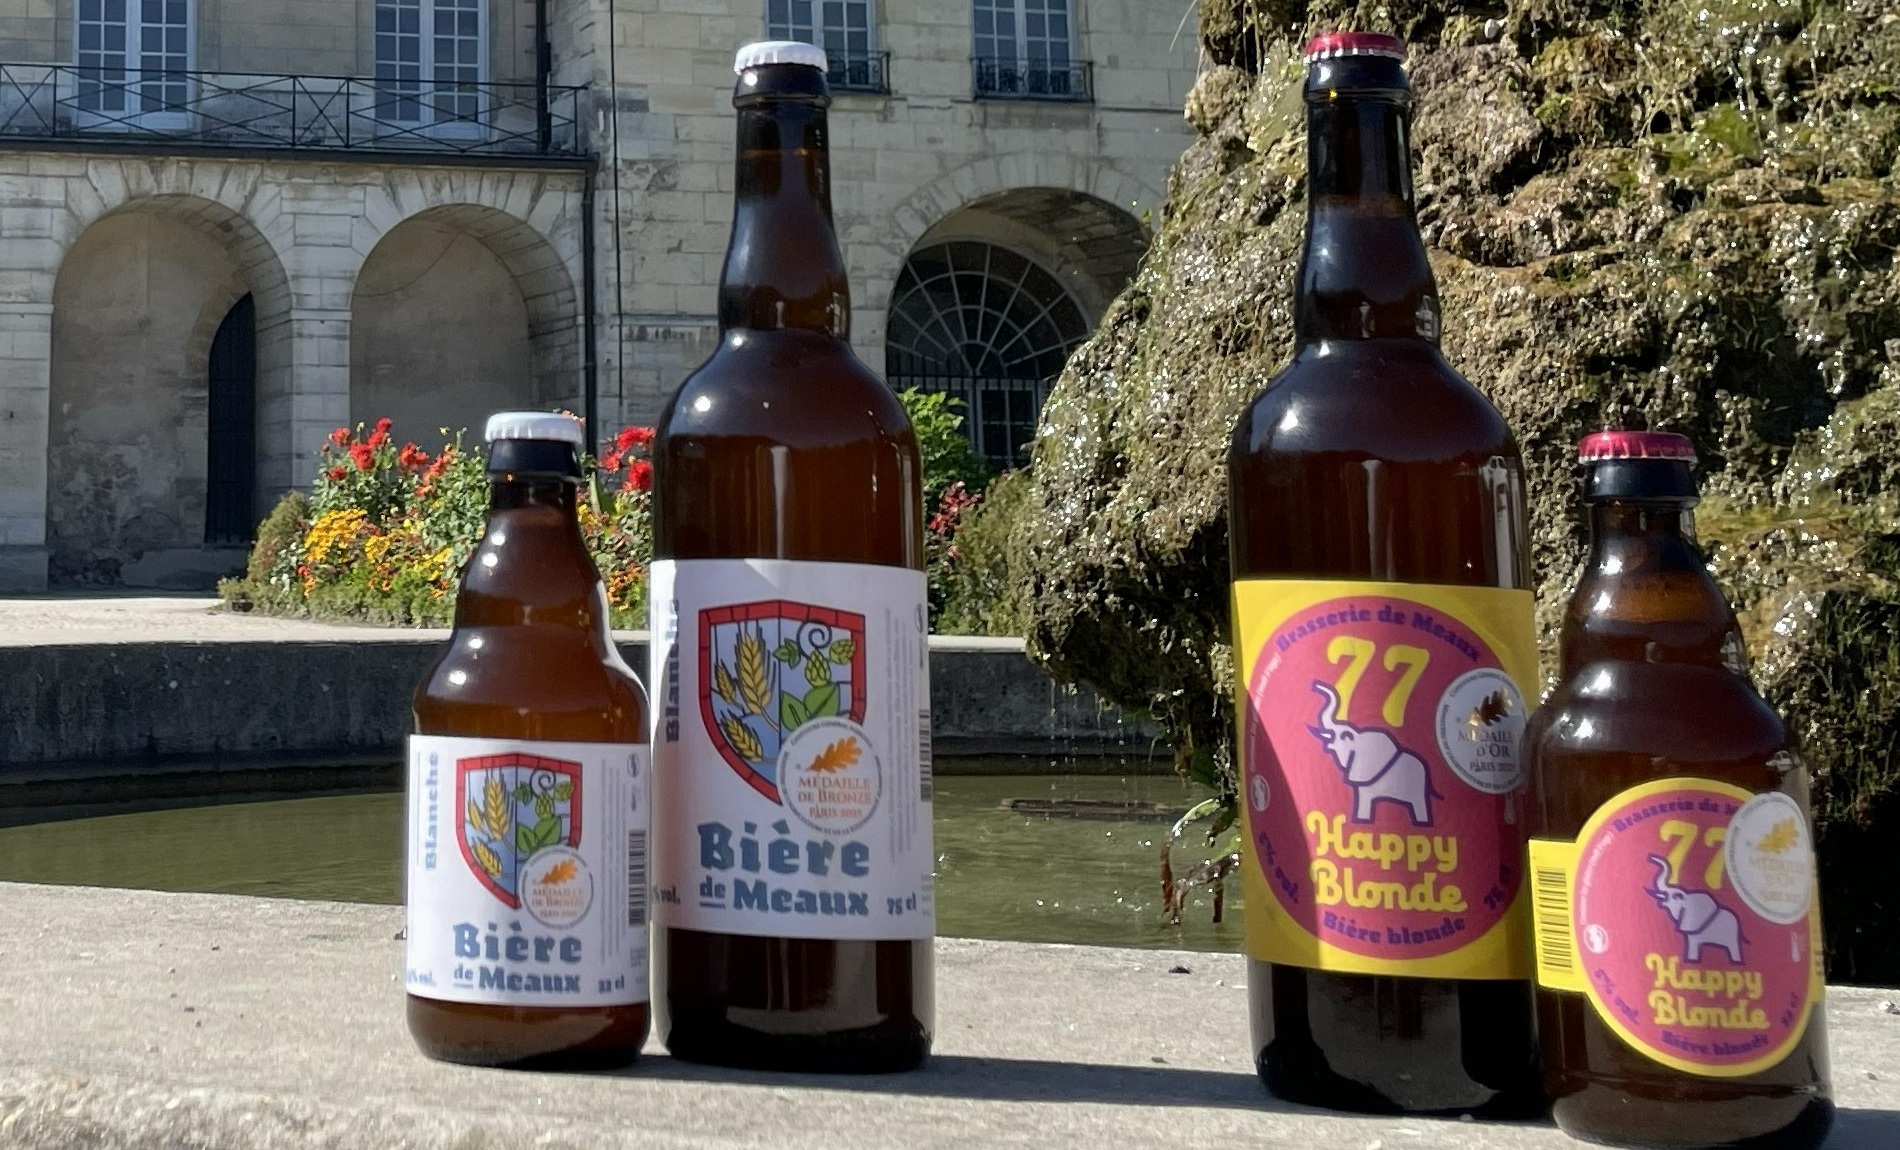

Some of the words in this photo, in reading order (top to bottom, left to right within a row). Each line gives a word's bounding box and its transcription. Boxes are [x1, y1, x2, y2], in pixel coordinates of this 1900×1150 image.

[1275, 604, 1371, 651] Brasserie
[1377, 605, 1406, 625] de
[1411, 611, 1479, 662] Meaux
[1326, 635, 1431, 727] 77
[425, 752, 438, 869] Blanche
[798, 791, 815, 803] DE
[1612, 798, 1694, 832] Brasserie
[1698, 797, 1719, 813] de
[697, 819, 870, 876] Bière
[1306, 810, 1458, 873] Happy
[1659, 819, 1727, 890] 77
[700, 875, 725, 899] de
[733, 878, 868, 916] Meaux
[1310, 858, 1469, 913] Blonde
[453, 921, 582, 964] Bière
[1323, 911, 1381, 943] Bière
[1386, 917, 1466, 944] blonde
[454, 963, 474, 981] de
[478, 966, 581, 994] Meaux
[1645, 953, 1763, 999] Happy
[1648, 989, 1770, 1029] Blonde
